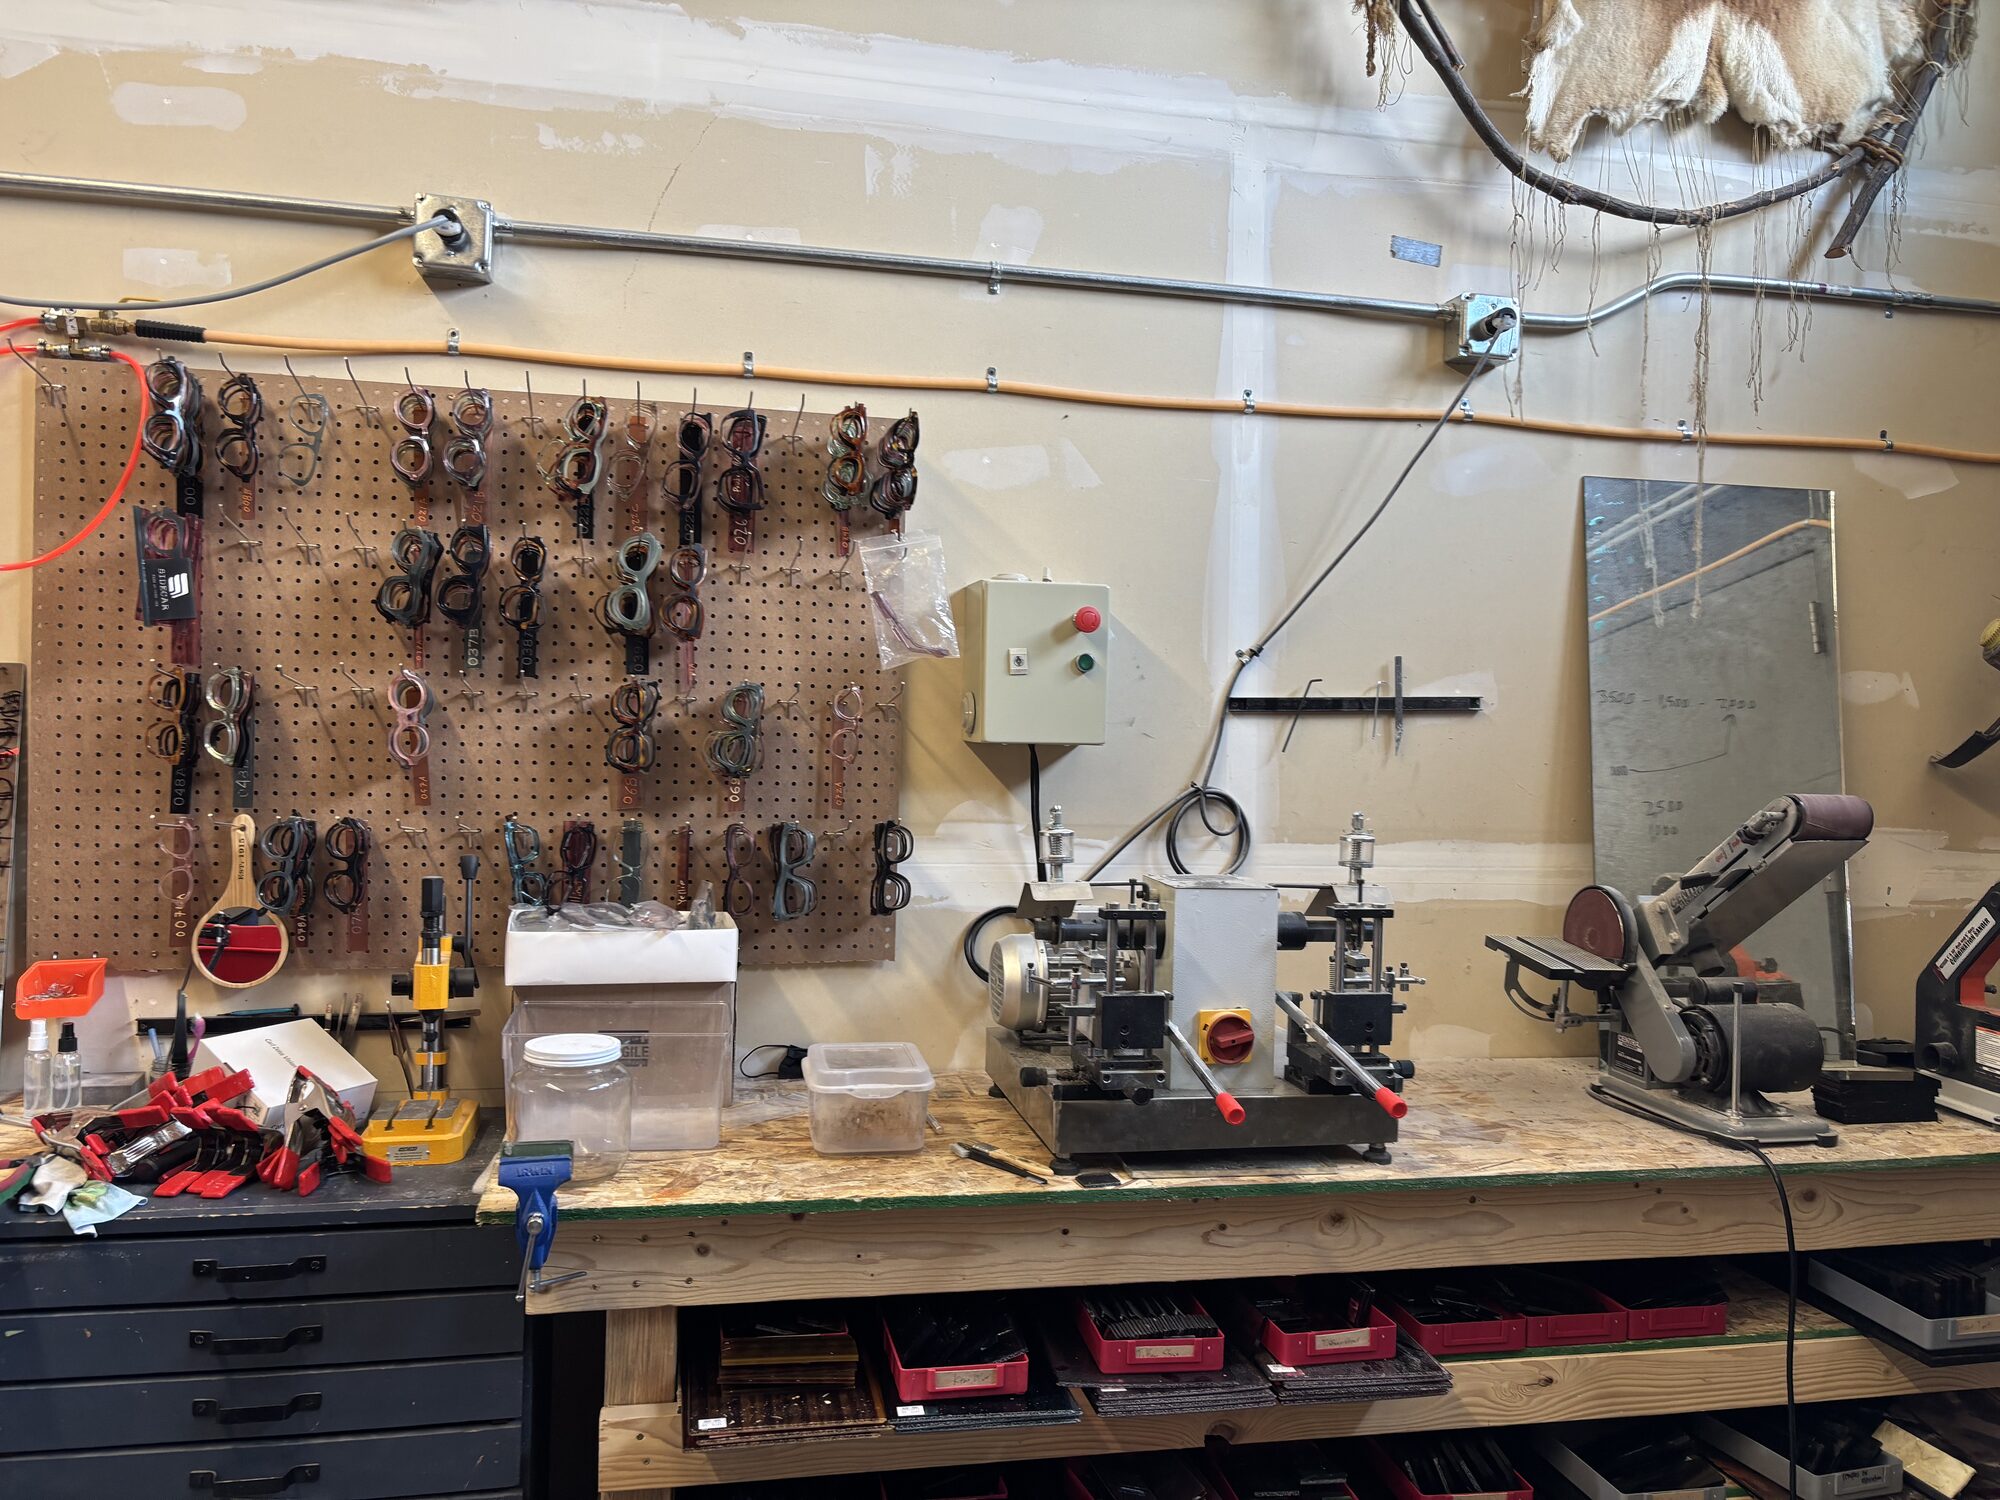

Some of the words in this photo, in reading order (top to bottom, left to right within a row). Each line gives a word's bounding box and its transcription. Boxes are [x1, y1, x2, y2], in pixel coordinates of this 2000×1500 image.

[157, 567, 170, 611] SIDECAR
[467, 628, 479, 666] 037B
[173, 767, 186, 806] 048A
[622, 1046, 649, 1057] GILE
